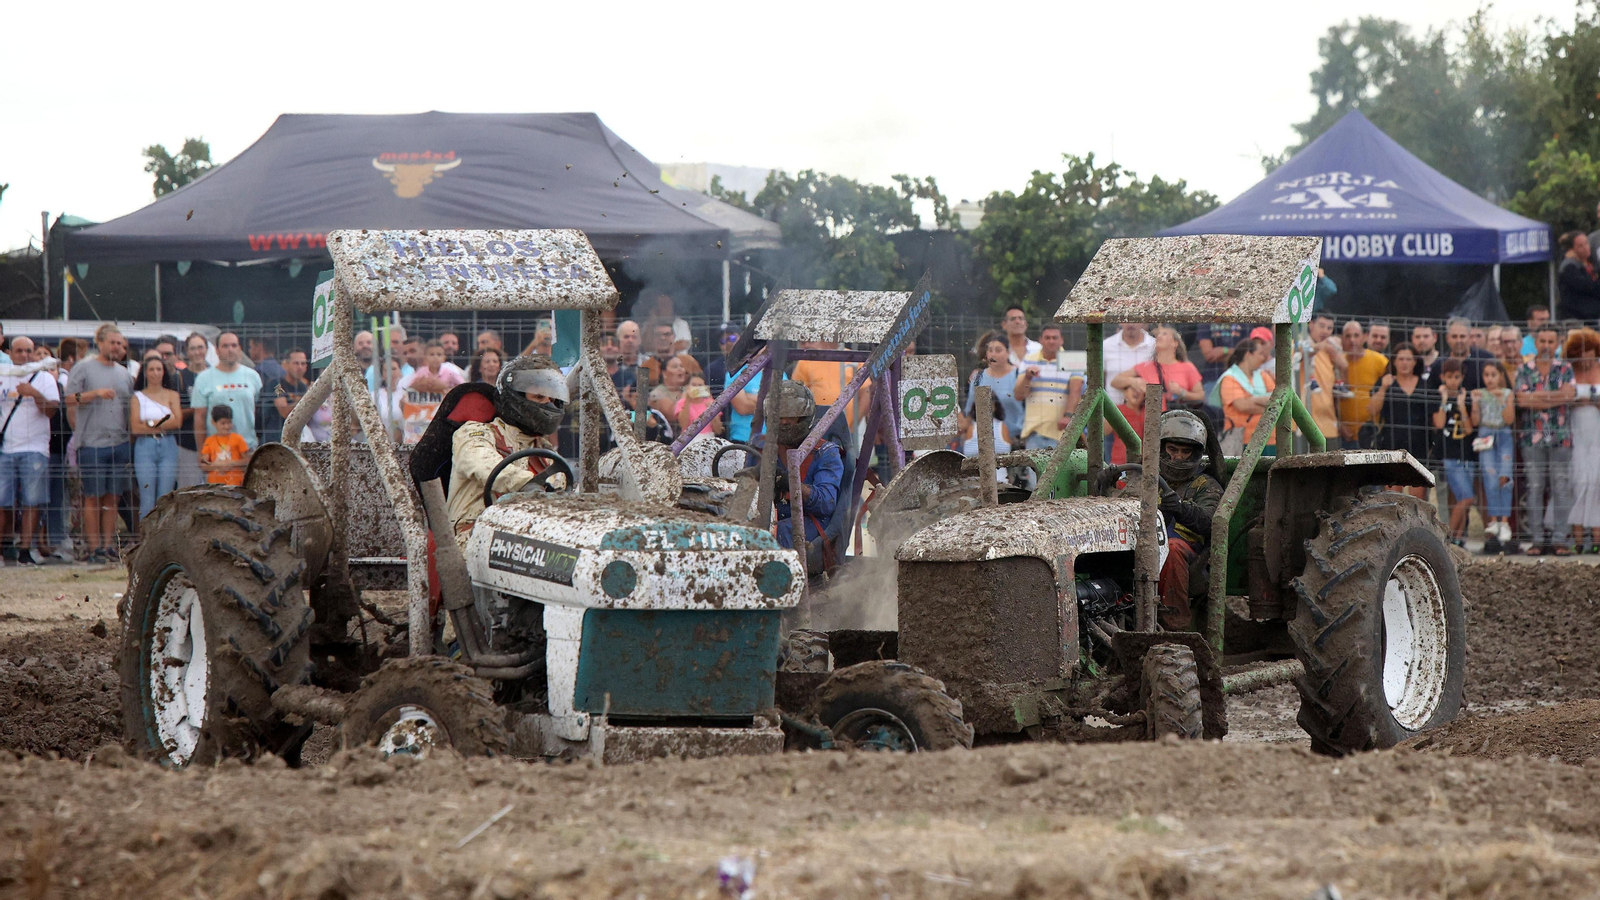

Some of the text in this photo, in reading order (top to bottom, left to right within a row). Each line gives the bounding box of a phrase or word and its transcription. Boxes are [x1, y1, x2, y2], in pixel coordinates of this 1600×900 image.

[1274, 171, 1402, 191] NERJA
[1325, 232, 1455, 259] HOBBY CLUB
[1287, 264, 1315, 324] 02
[902, 385, 956, 421] 09
[642, 530, 676, 549] EL
